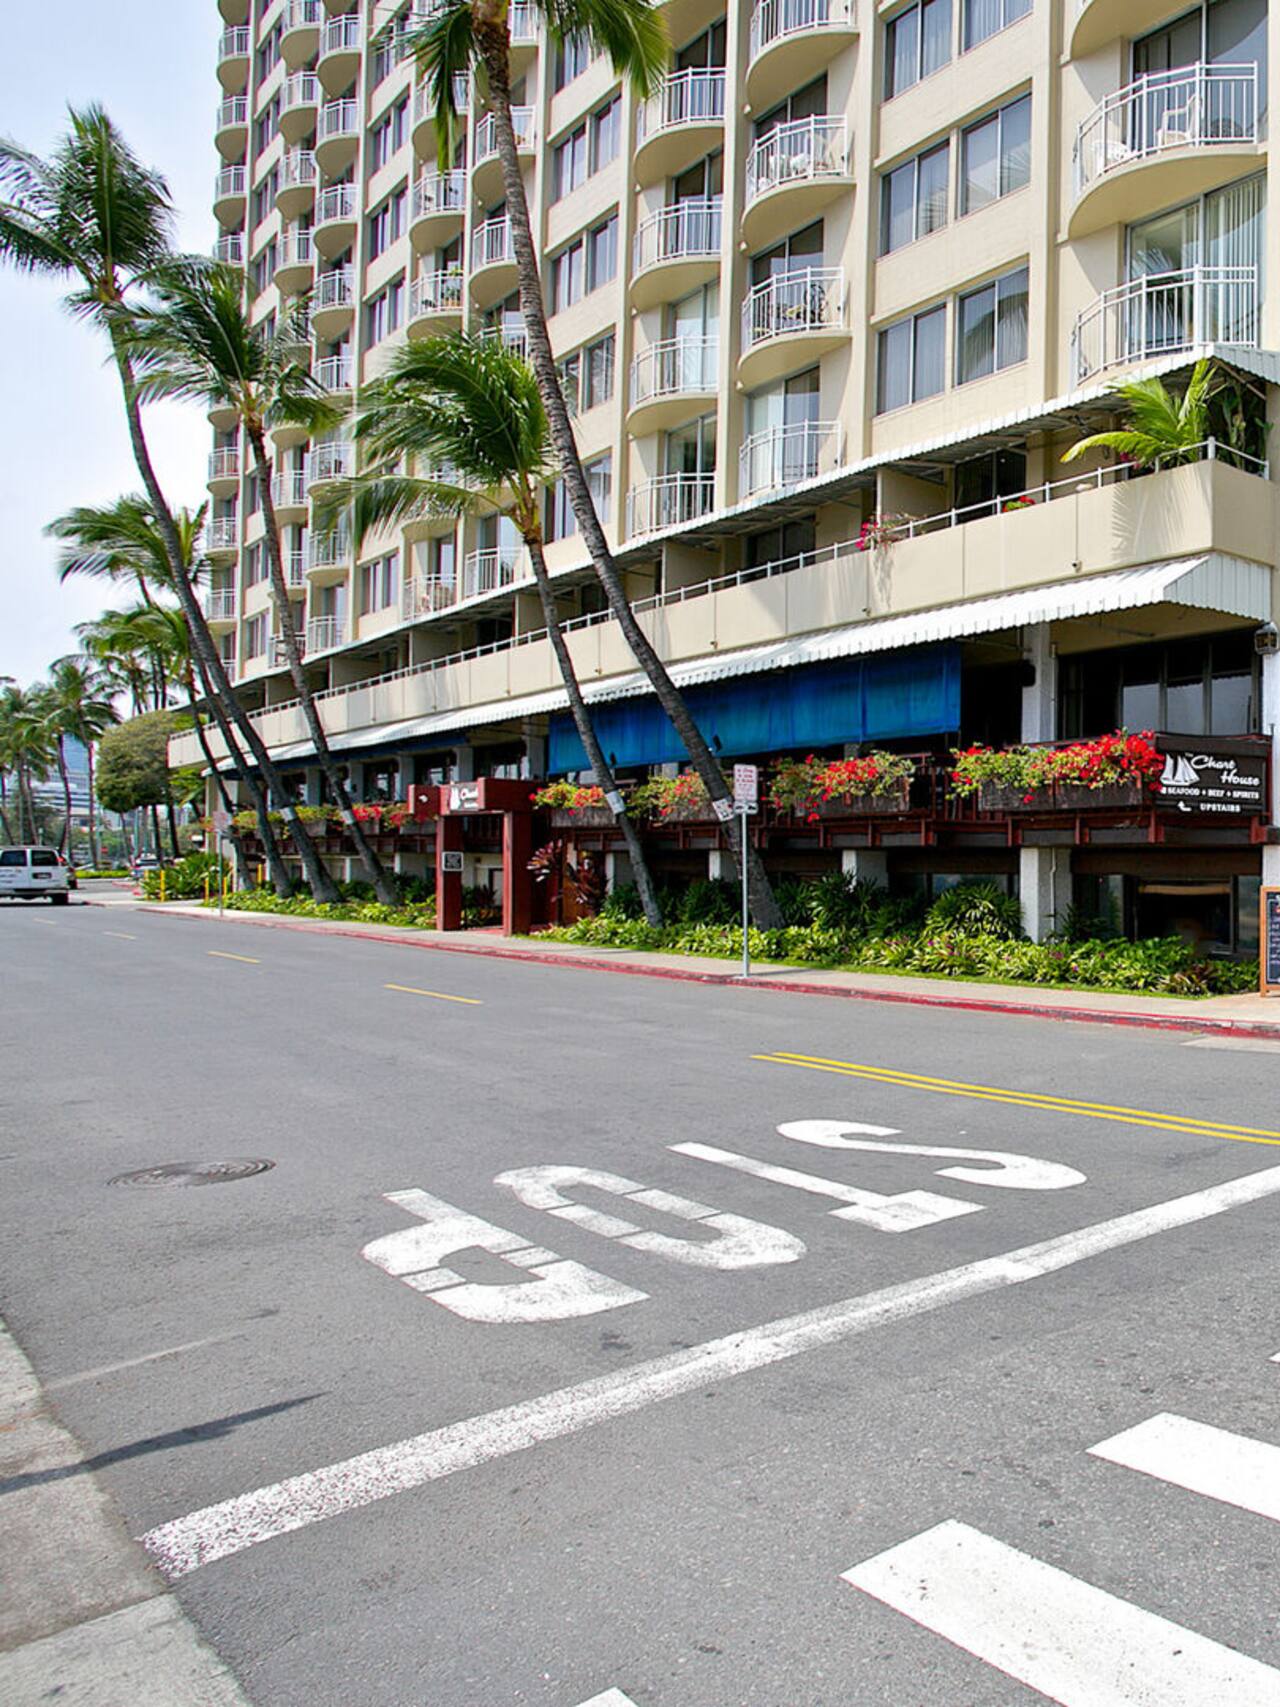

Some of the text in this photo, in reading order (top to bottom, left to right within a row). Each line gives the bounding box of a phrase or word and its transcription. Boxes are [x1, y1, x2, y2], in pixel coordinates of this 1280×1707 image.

[1191, 755, 1236, 769] Chart
[1220, 769, 1260, 786] House
[1168, 786, 1200, 796] SEAFOOD
[1232, 790, 1260, 799] SPIRITS
[1200, 803, 1241, 812] UPSTAIRS
[361, 1119, 1087, 1323] STOP
